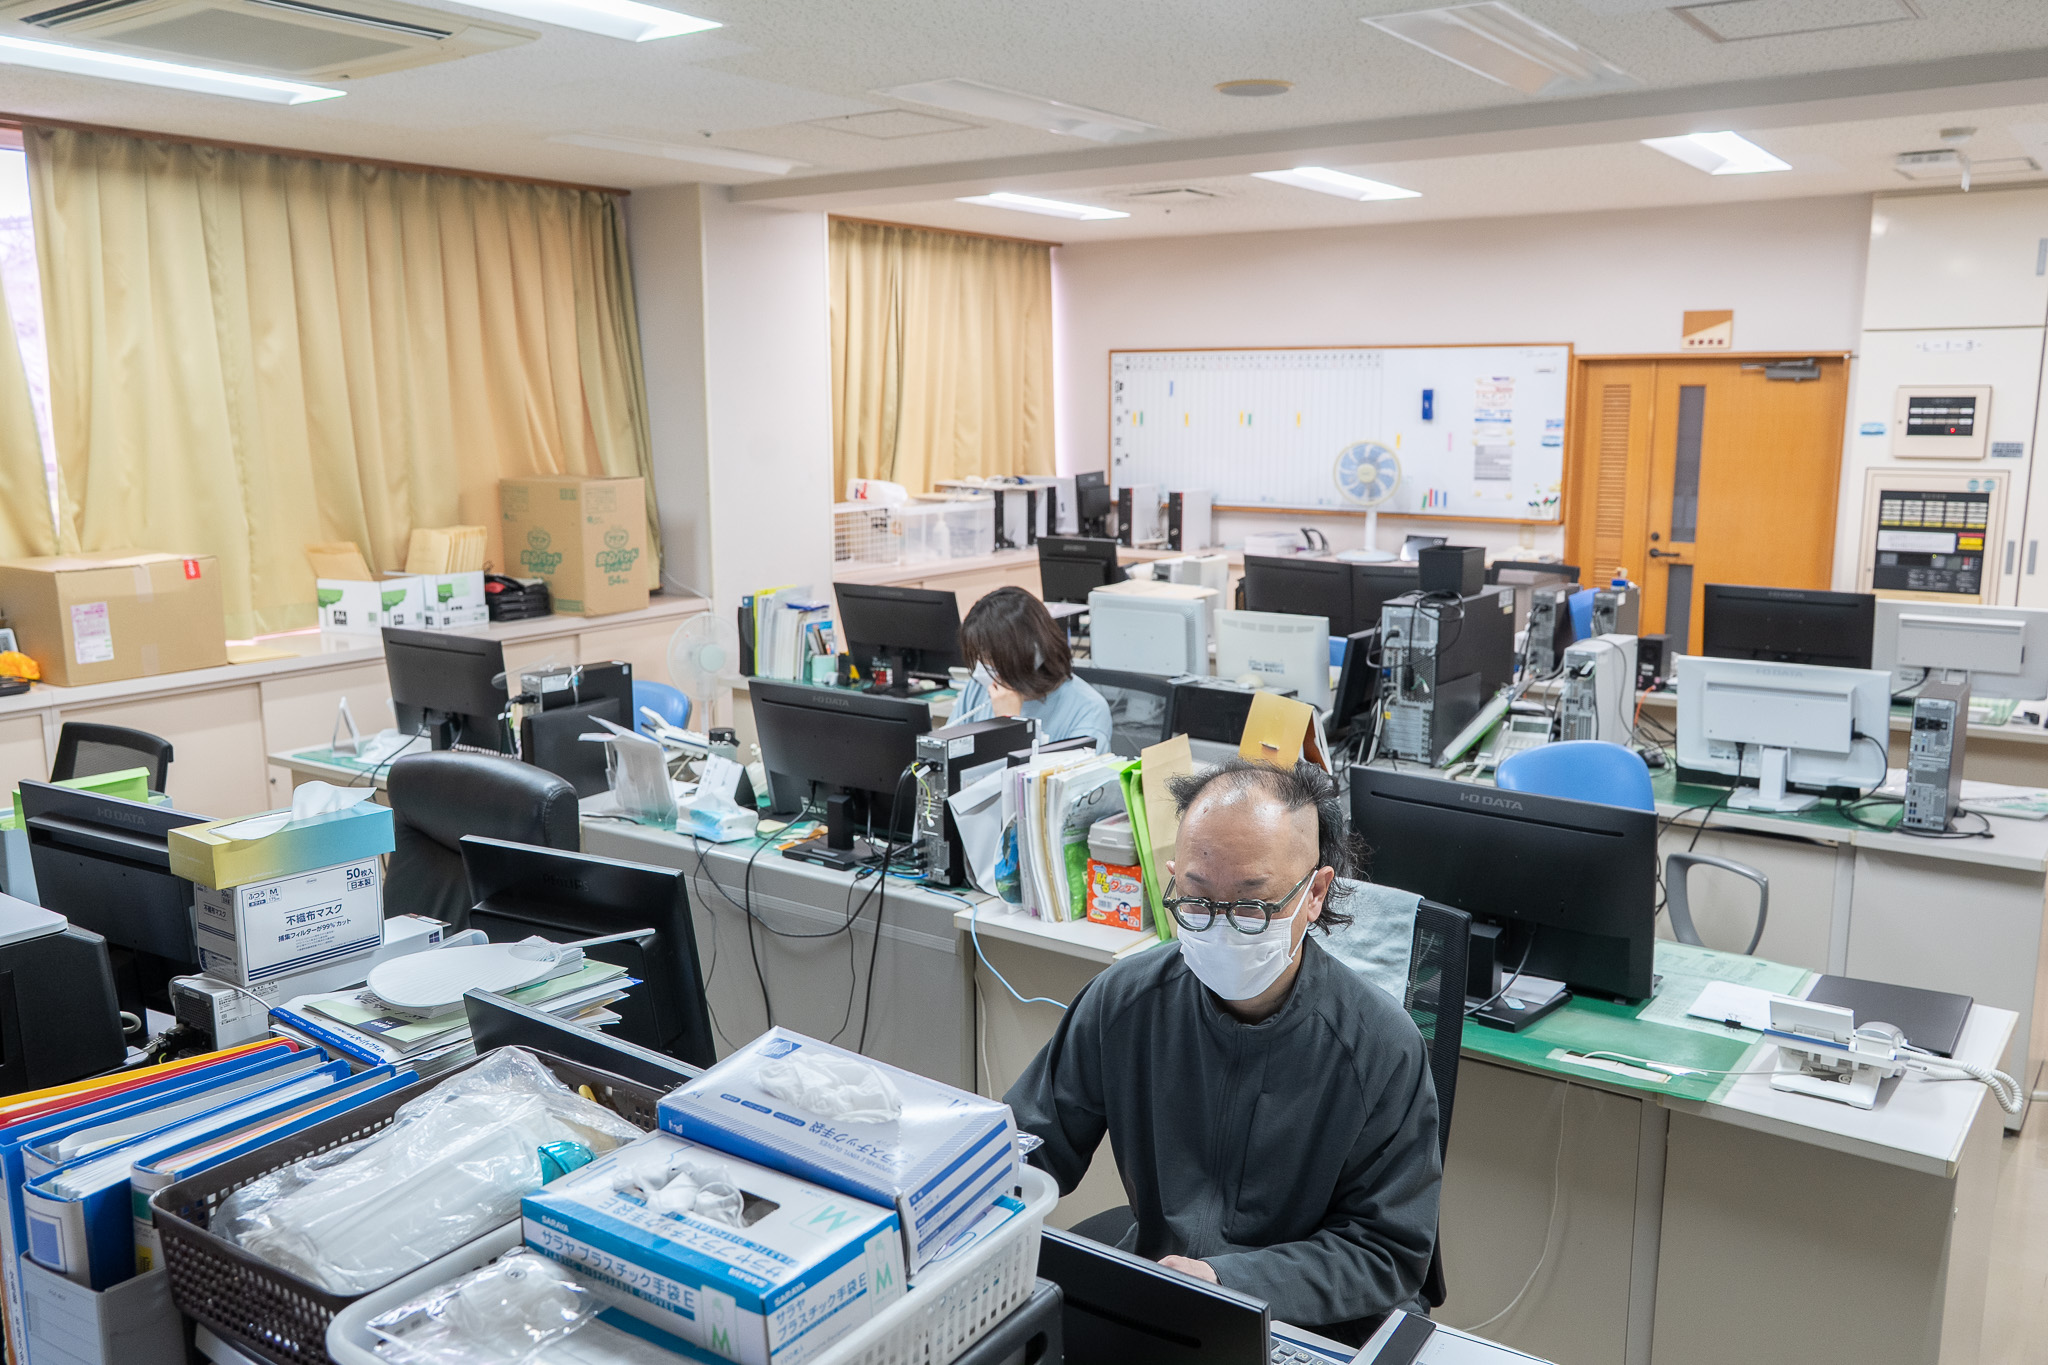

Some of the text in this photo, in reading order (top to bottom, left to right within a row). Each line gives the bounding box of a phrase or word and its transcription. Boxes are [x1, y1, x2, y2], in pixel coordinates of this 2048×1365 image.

[825, 697, 849, 706] DATA
[1482, 796, 1524, 811] DATA
[114, 811, 146, 826] DATA
[346, 868, 374, 880] 50枚入
[350, 879, 371, 890] 日本製
[248, 891, 265, 900] ふつう
[285, 904, 343, 926] 不織布マスク
[541, 1214, 569, 1233] SARAYA
[807, 1204, 862, 1234] M
[542, 1230, 576, 1255] サラヤ
[876, 1262, 893, 1294] M
[774, 1282, 807, 1307] SARAYA
[776, 1298, 806, 1324] サラヤ
[712, 1323, 732, 1355] M
